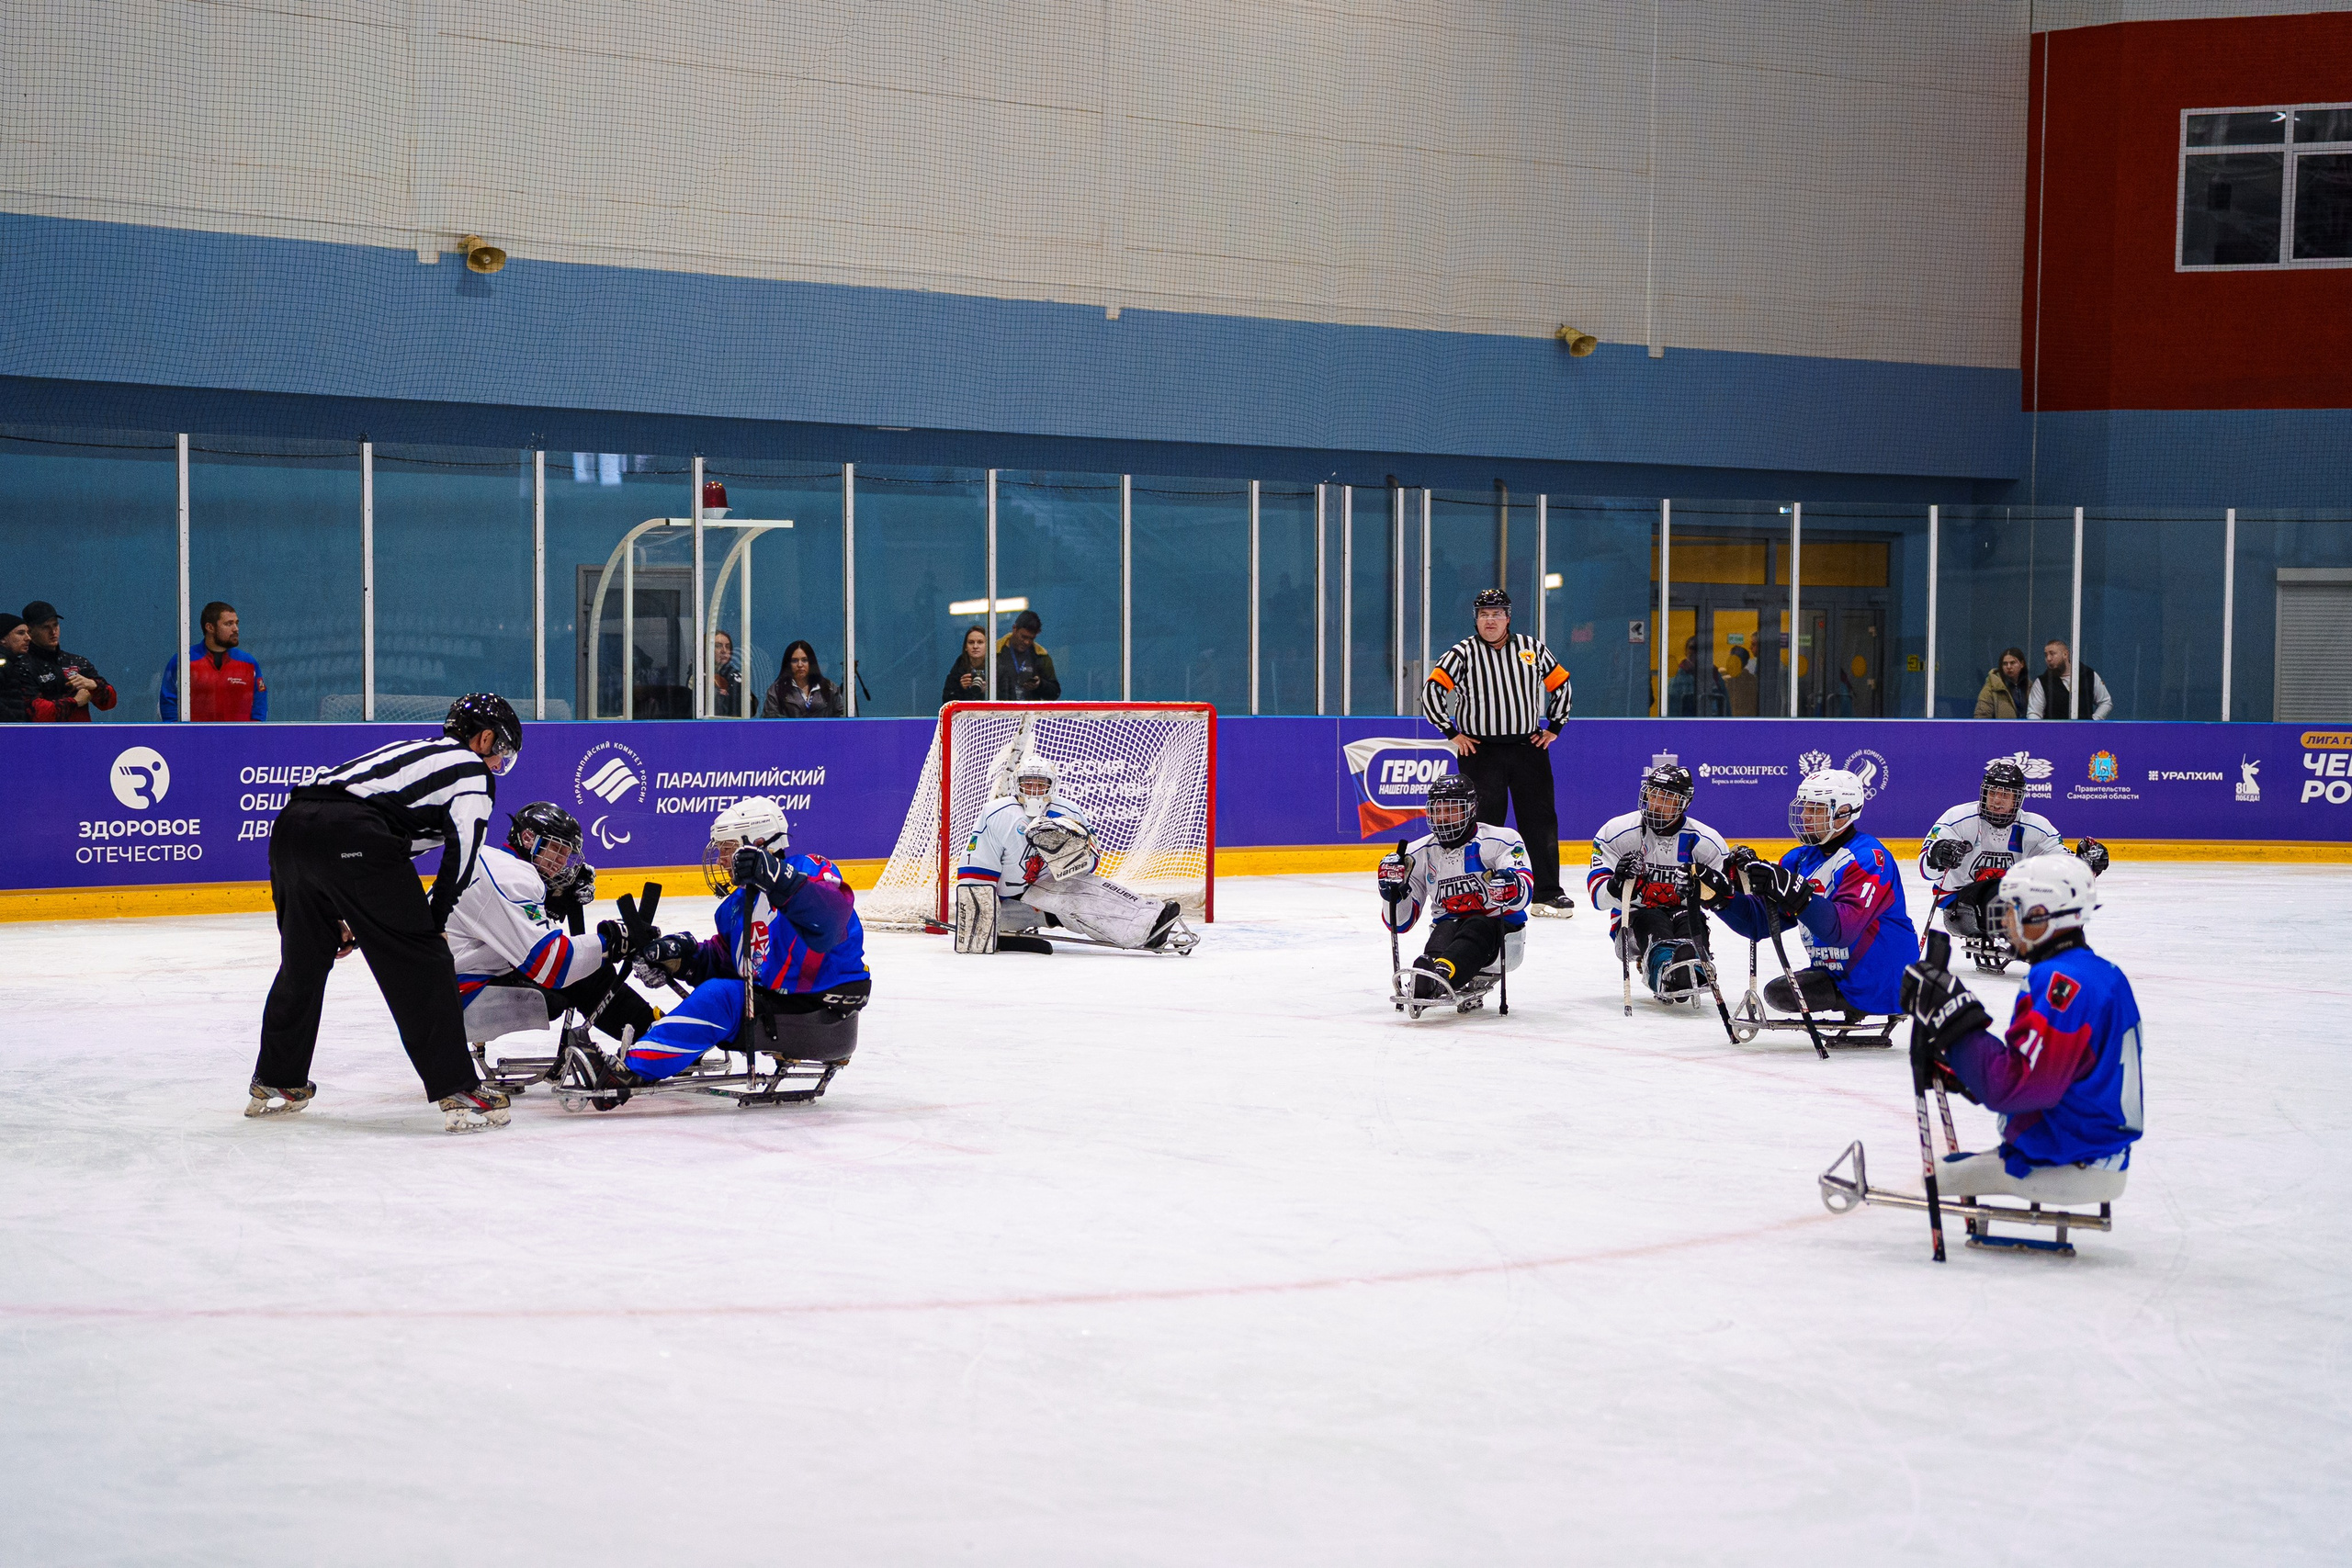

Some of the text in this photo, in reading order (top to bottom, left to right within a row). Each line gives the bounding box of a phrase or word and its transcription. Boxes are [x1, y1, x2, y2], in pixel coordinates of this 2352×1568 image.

[2306, 736, 2352, 745] ЛИГА Г
[574, 740, 647, 805] ПАРАЛИМПИЙСКИЙ КОМИТЕТ РОССИИ
[1380, 760, 1449, 783] ГЕРОИ
[1711, 765, 1788, 776] РОСКОНГРЕСС
[2302, 752, 2352, 777] ЧЕ
[240, 765, 330, 786] ОБЩЕР
[655, 766, 826, 789] ПАРАЛИМПИЙСКИЙ
[2161, 771, 2223, 781] УРАЛХИМ
[1378, 784, 1434, 795] НАШЕГО ВРЕМ
[2024, 783, 2052, 792] СКИЙ
[2066, 793, 2108, 801] Самарской
[656, 795, 739, 814] КОМИТЕТ
[78, 818, 201, 840] ЗДОРОВОЕ
[75, 844, 203, 863] ОТЕЧЕСТВО
[1102, 882, 1138, 902] BAUER
